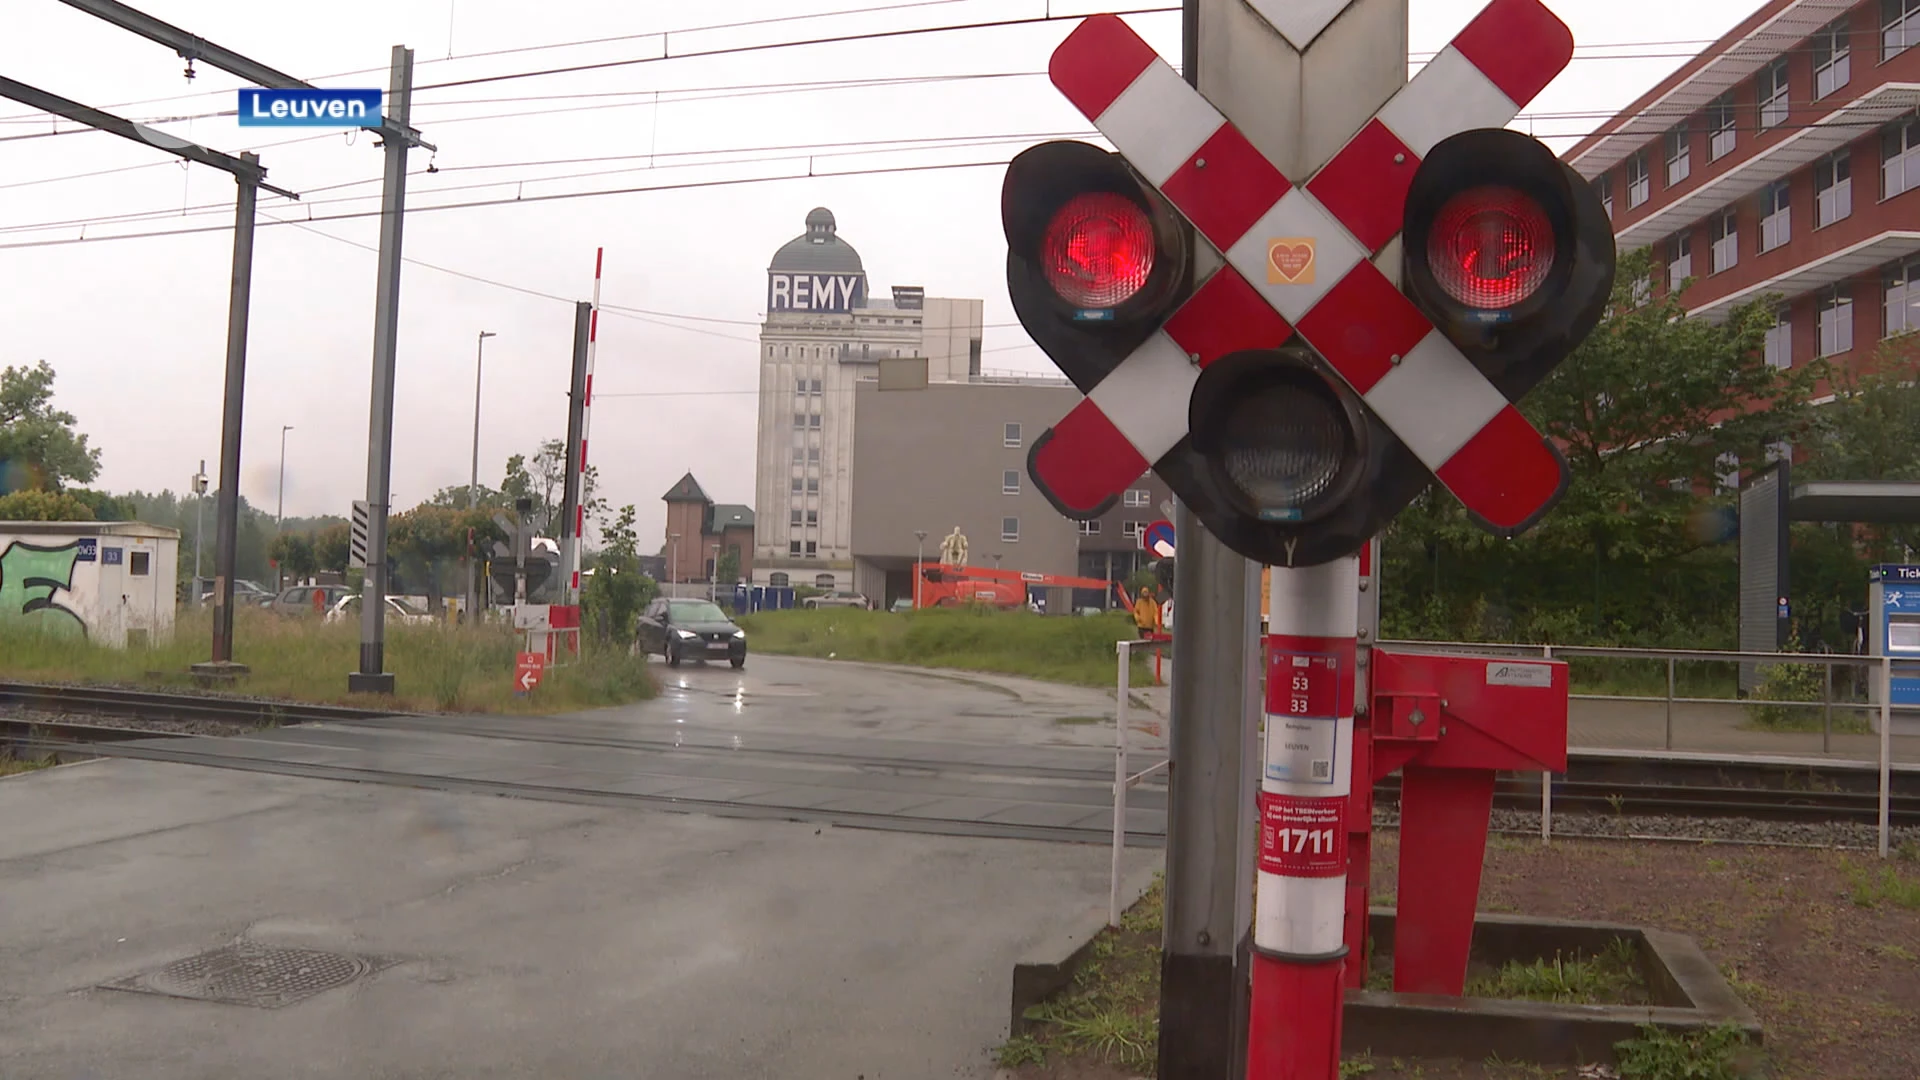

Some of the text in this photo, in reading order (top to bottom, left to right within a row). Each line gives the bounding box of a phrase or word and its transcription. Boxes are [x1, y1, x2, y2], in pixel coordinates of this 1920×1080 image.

[771, 274, 857, 310] REMY
[107, 551, 117, 561] 33
[1292, 677, 1308, 690] 53
[1291, 700, 1308, 713] 33
[1285, 743, 1310, 752] LEUVEN
[1269, 804, 1282, 812] STOP
[1283, 806, 1294, 814] het
[1279, 827, 1334, 854] 1711
